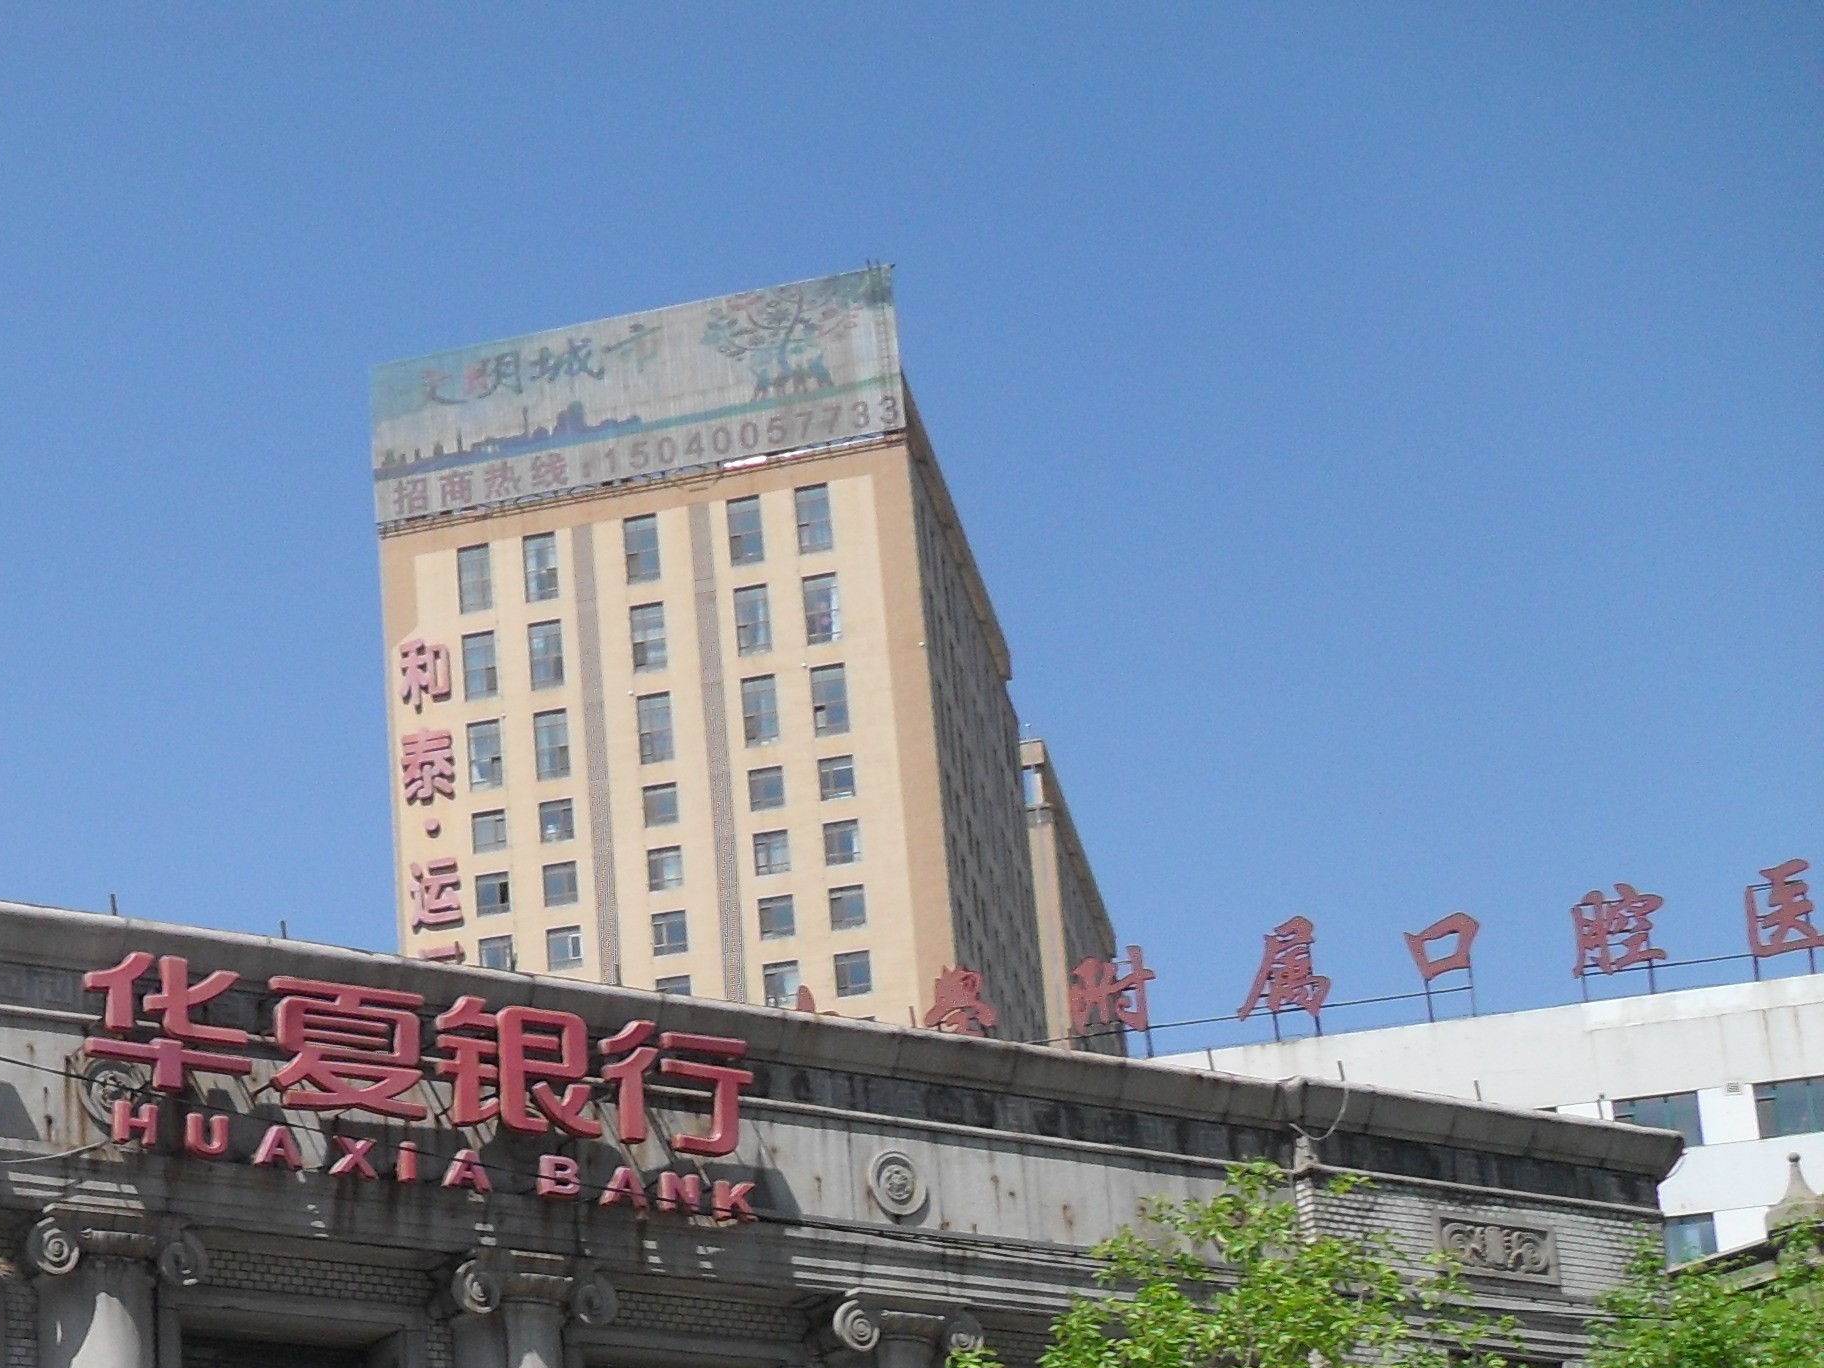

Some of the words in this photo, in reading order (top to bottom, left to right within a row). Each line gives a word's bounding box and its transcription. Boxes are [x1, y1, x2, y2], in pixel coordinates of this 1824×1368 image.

[399, 637, 465, 965] 和泰·运
[83, 951, 754, 1157] 华夏银行
[111, 1099, 494, 1195] HUAXIA
[536, 1153, 760, 1224] BANK
